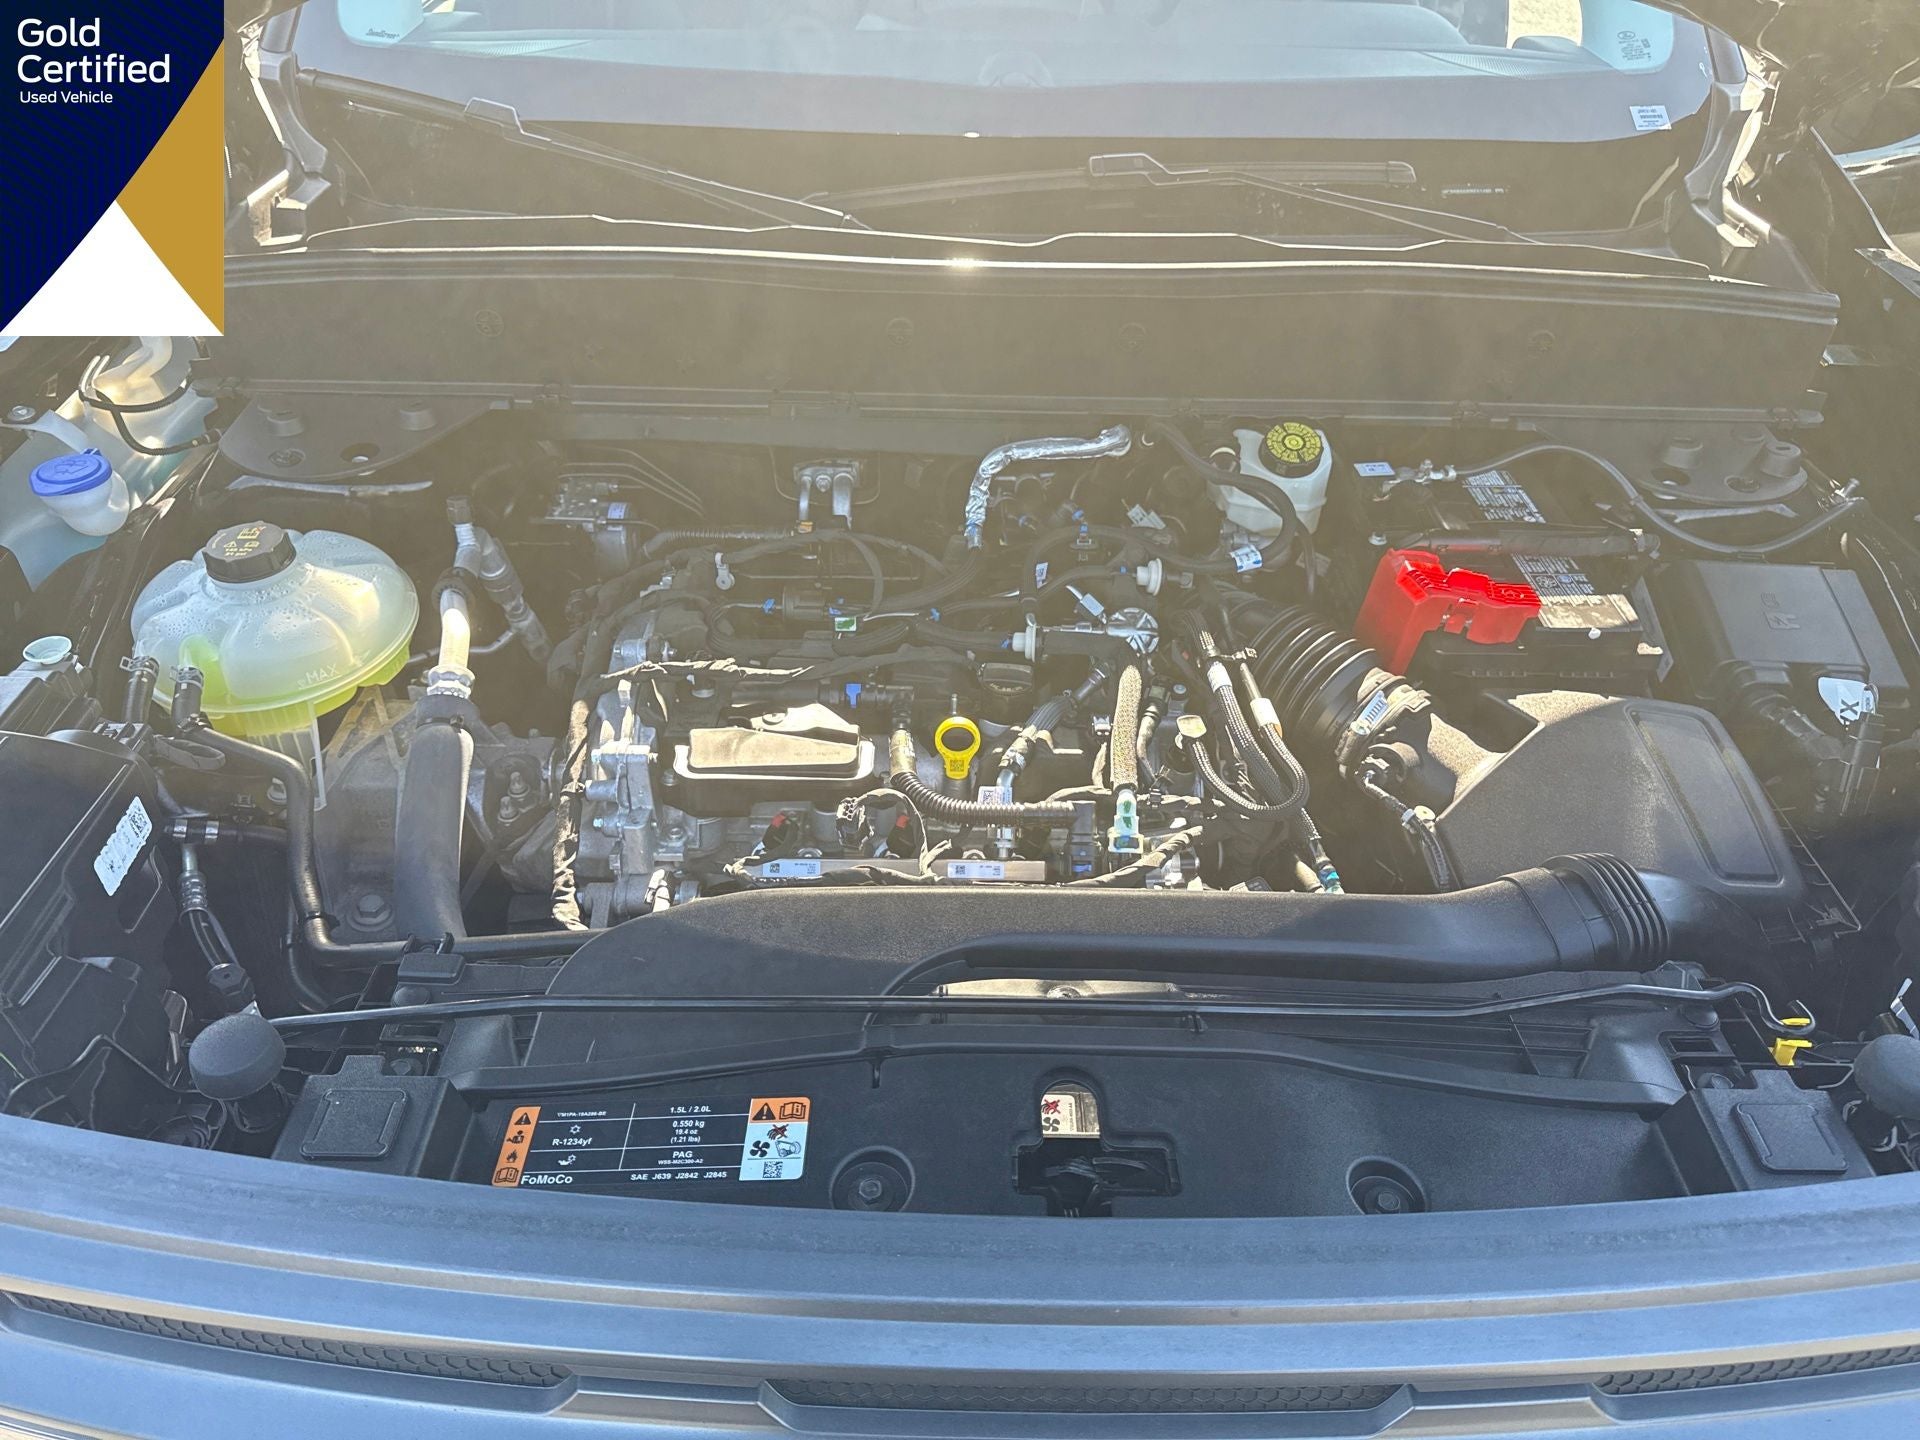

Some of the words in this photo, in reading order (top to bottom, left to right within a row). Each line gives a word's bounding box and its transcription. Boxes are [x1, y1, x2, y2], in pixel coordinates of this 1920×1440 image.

[305, 663, 340, 684] MAX
[670, 1106, 687, 1114] 1.5L
[693, 1105, 712, 1113] 2.0L
[672, 1119, 694, 1128] 0.550
[694, 1119, 705, 1129] kg
[552, 1137, 593, 1147] R-1234yf
[687, 1135, 701, 1143] lbs)
[672, 1150, 693, 1159] PAG
[520, 1173, 573, 1185] FoMoCo
[630, 1173, 649, 1181] SAE
[651, 1172, 672, 1180] J639
[674, 1172, 699, 1180] J2842
[703, 1171, 728, 1179] J2845
